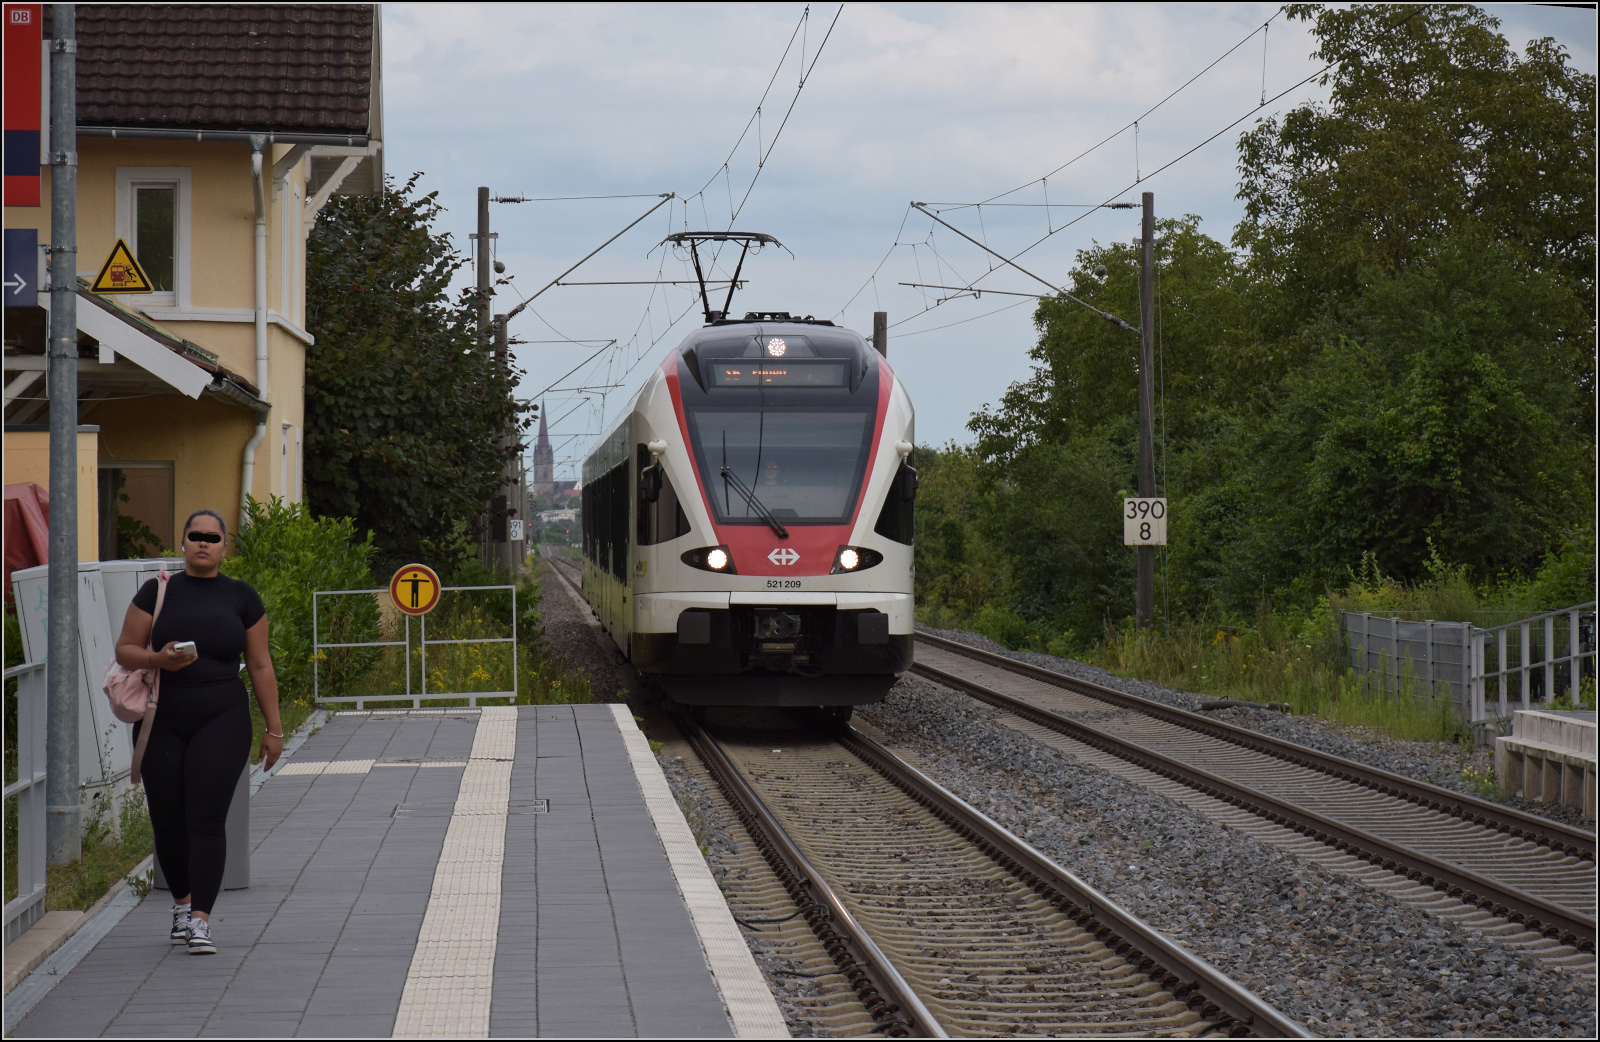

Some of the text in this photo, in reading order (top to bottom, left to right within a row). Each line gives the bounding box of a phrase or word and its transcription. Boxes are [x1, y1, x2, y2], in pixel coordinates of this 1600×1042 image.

[12, 11, 29, 22] DB
[1126, 500, 1165, 519] 390
[511, 520, 521, 529] 91
[1139, 521, 1151, 541] 8
[766, 580, 802, 588] 521 209
